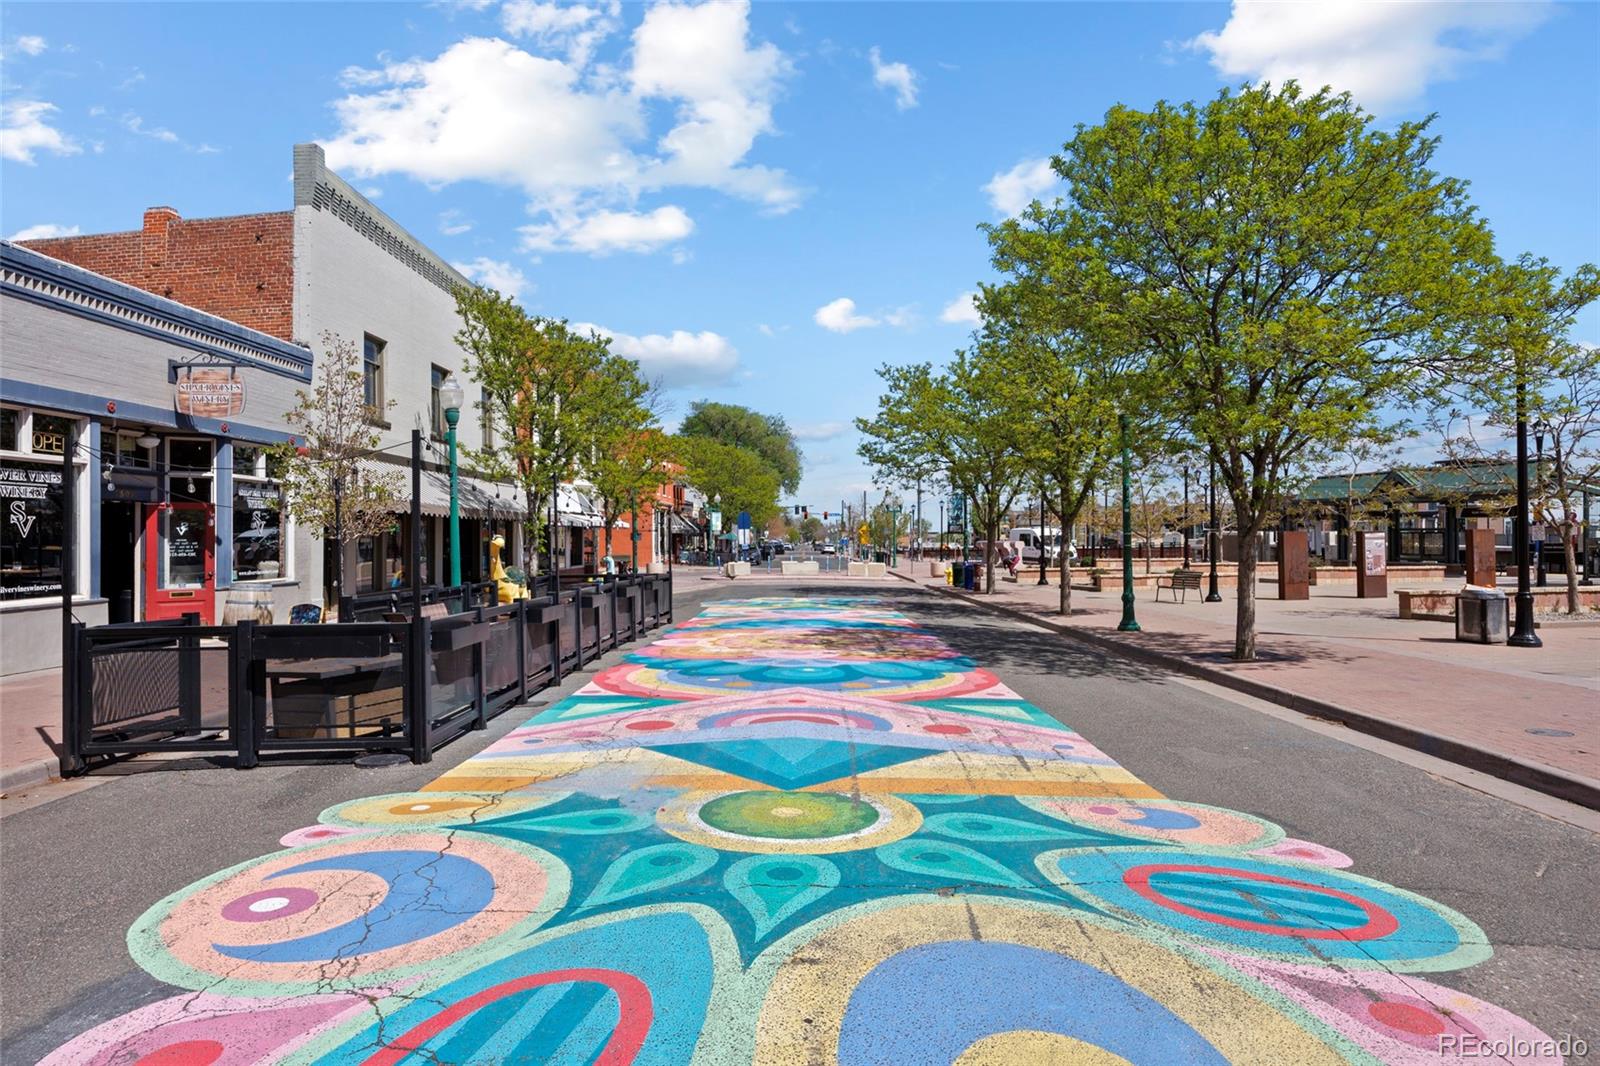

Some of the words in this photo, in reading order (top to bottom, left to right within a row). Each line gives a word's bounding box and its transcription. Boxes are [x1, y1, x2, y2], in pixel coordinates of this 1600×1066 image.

[191, 394, 230, 404] WINERY
[0, 468, 27, 481] VER
[27, 470, 62, 483] VINES
[0, 485, 48, 499] WINERY
